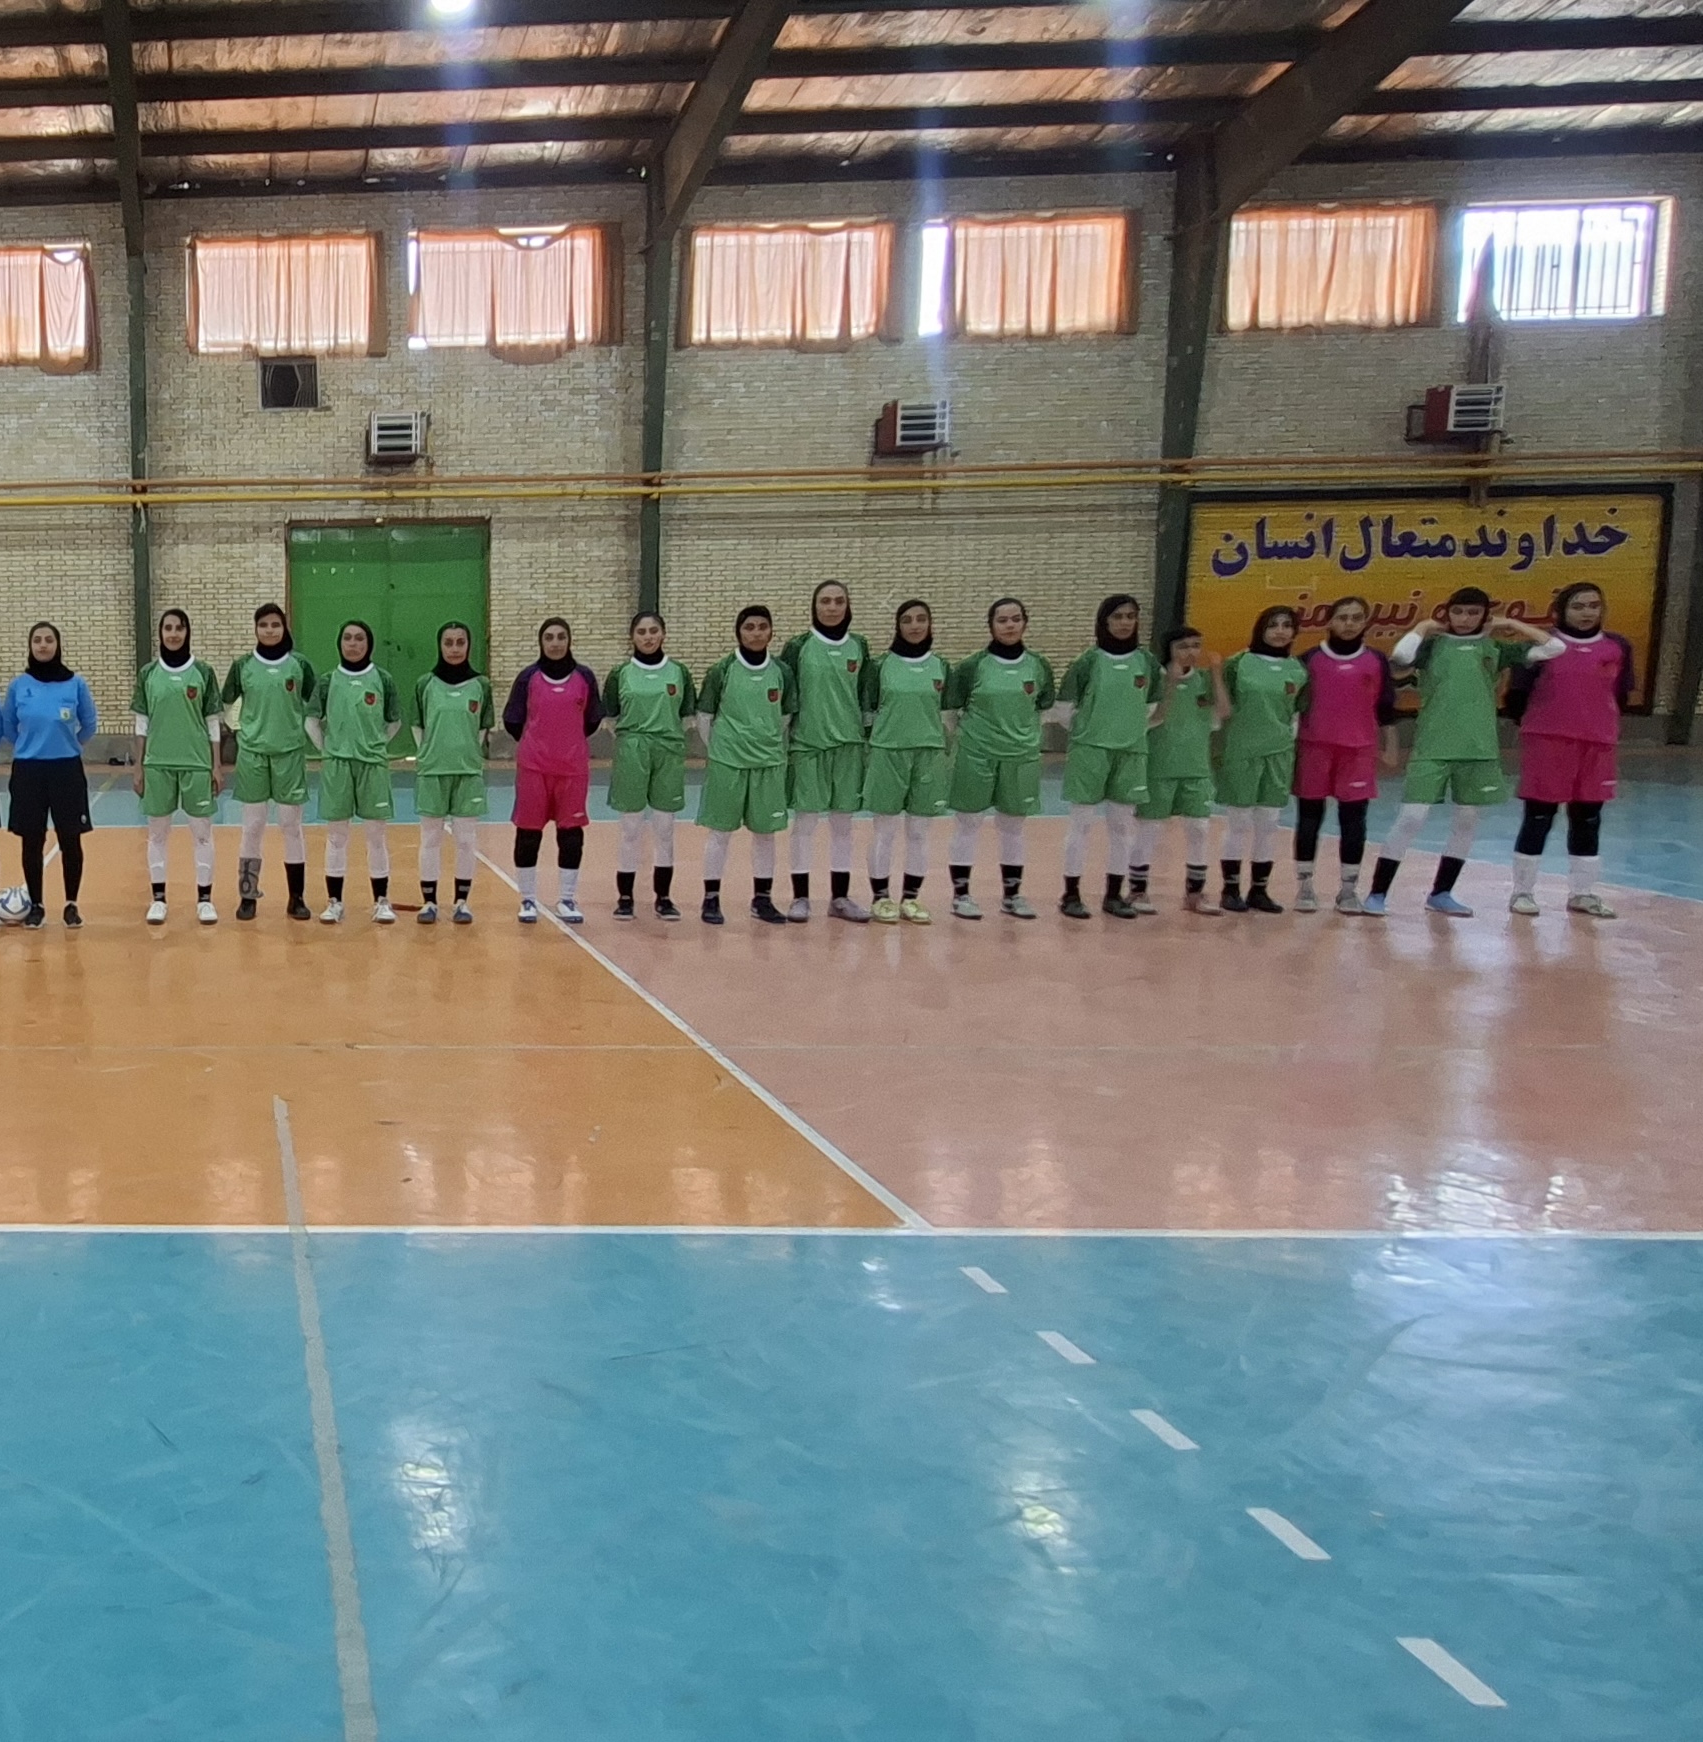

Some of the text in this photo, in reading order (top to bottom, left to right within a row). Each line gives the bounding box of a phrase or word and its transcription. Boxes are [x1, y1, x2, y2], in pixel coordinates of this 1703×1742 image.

[1210, 507, 1629, 577] خداوند متعال انسان
